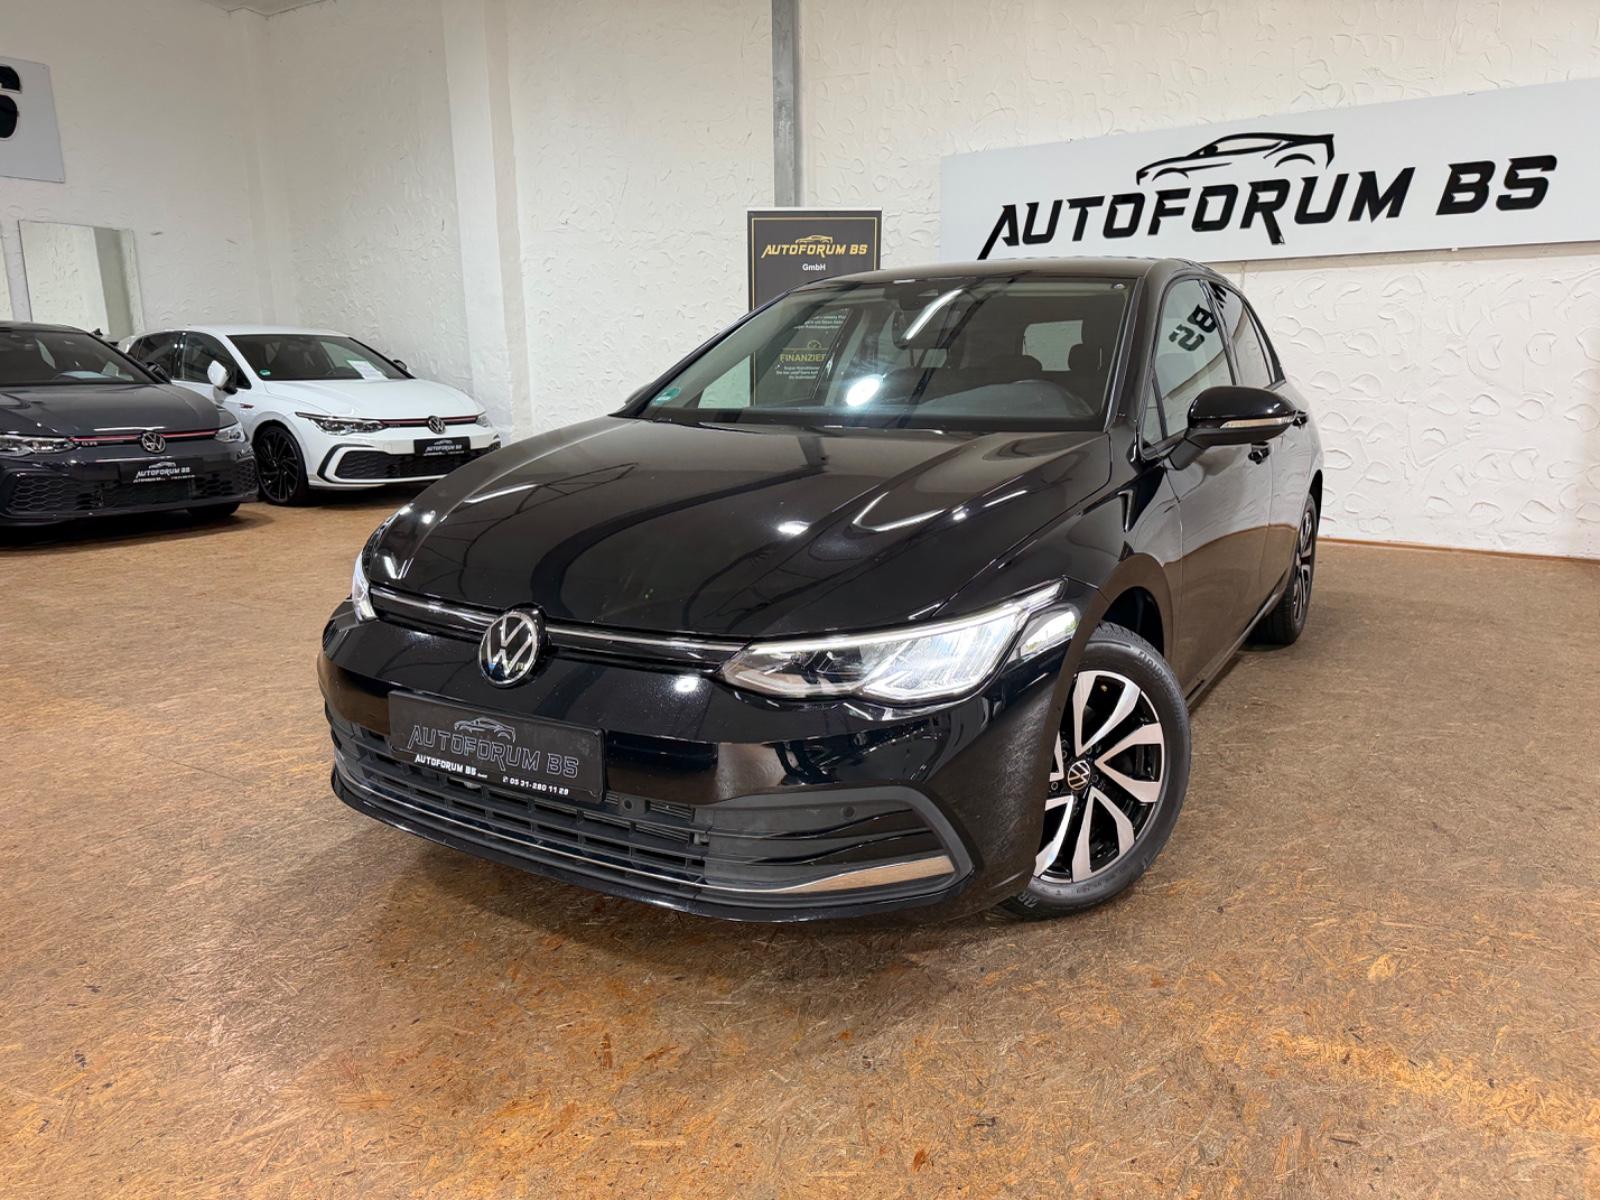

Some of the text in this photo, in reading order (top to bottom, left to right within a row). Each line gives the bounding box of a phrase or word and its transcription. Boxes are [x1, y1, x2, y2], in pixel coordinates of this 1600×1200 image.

[978, 155, 1557, 260] AUTOFORUM BS
[761, 244, 868, 259] AUTOFORUM BS
[802, 263, 826, 271] GmbH
[407, 725, 579, 779] AUTOFORUM BS
[414, 753, 463, 772] AUTOFORUM
